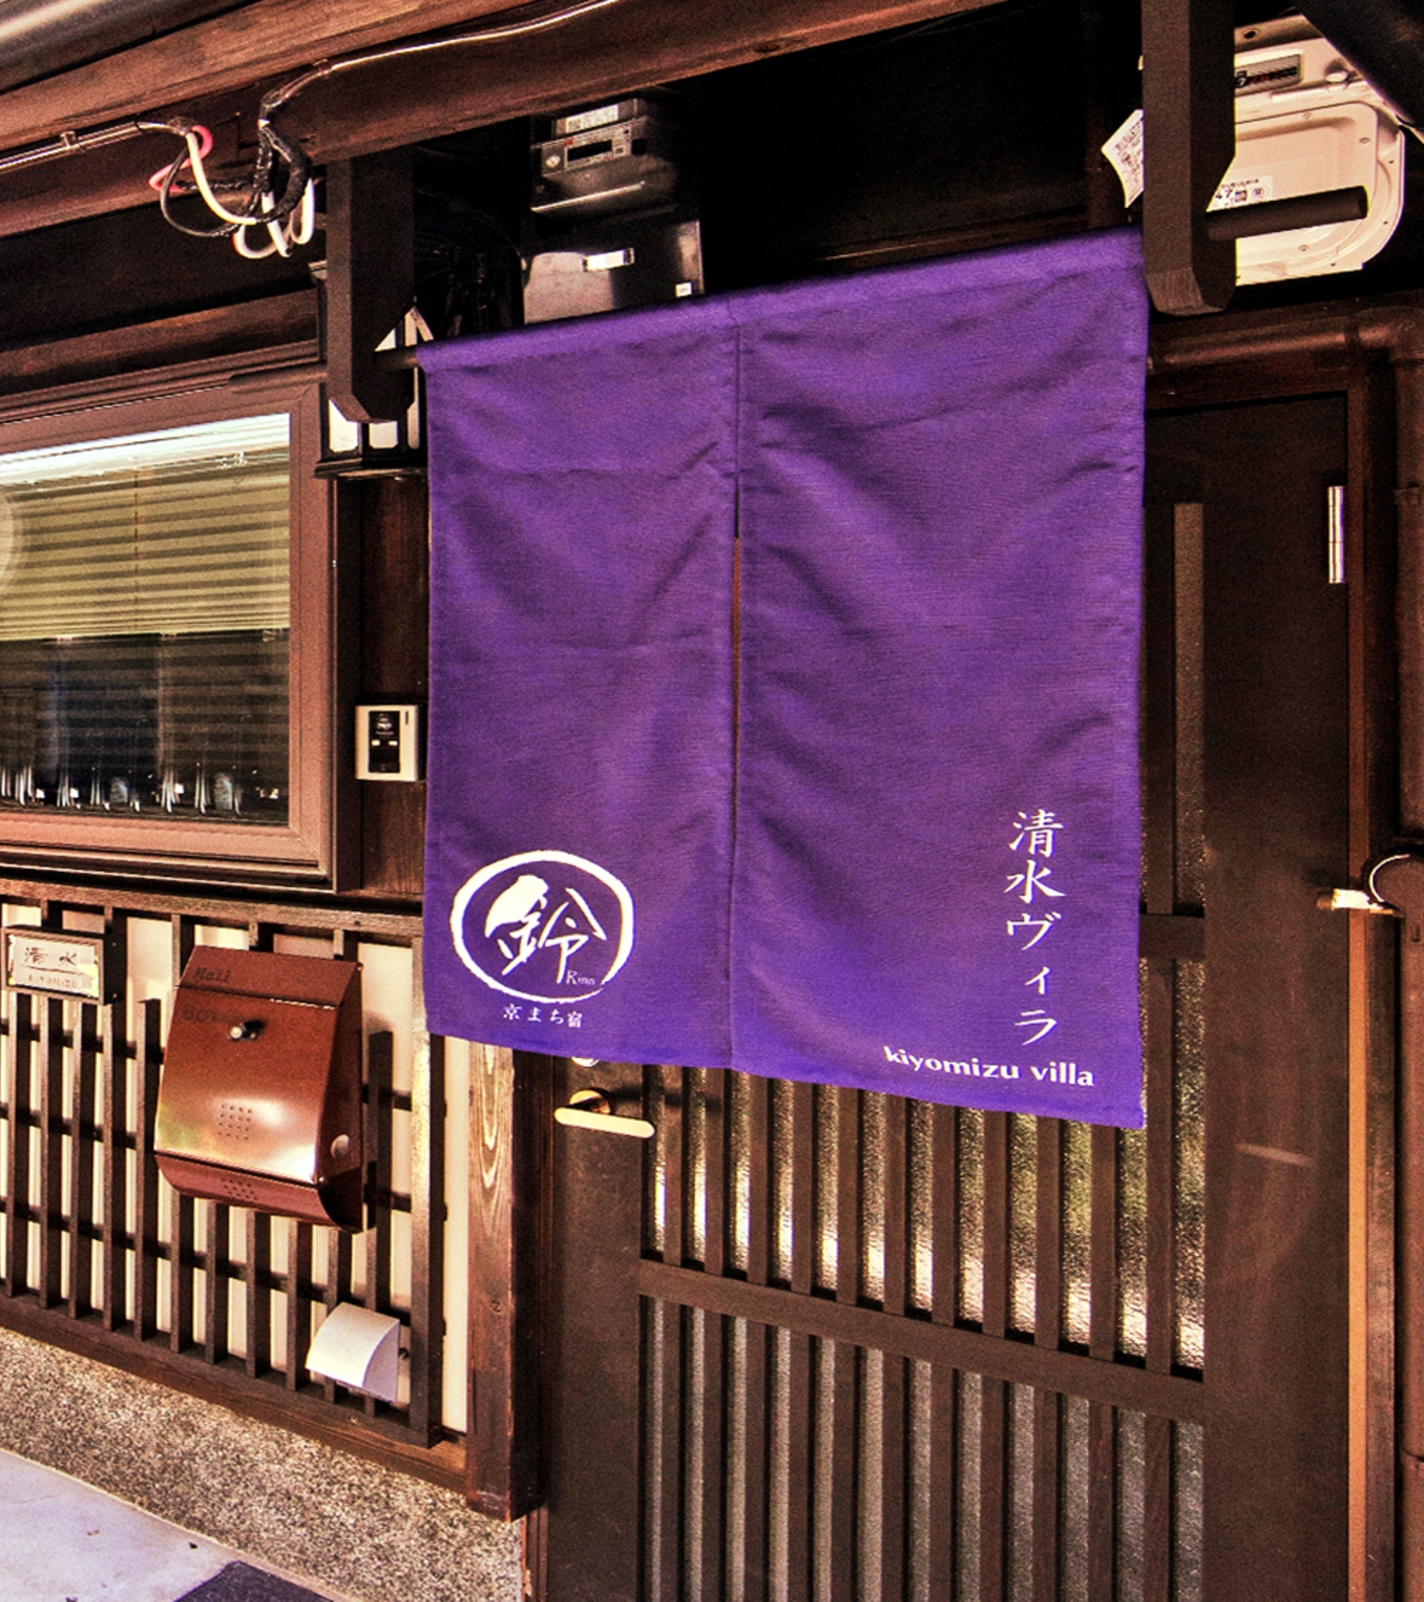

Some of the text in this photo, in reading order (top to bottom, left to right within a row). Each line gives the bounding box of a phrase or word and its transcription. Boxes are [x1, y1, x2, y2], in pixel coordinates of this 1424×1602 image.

[1004, 808, 1066, 1046] 清水ヴィラ
[503, 1004, 584, 1028] 京まち宿
[883, 1045, 1095, 1087] kiyomizu villa
